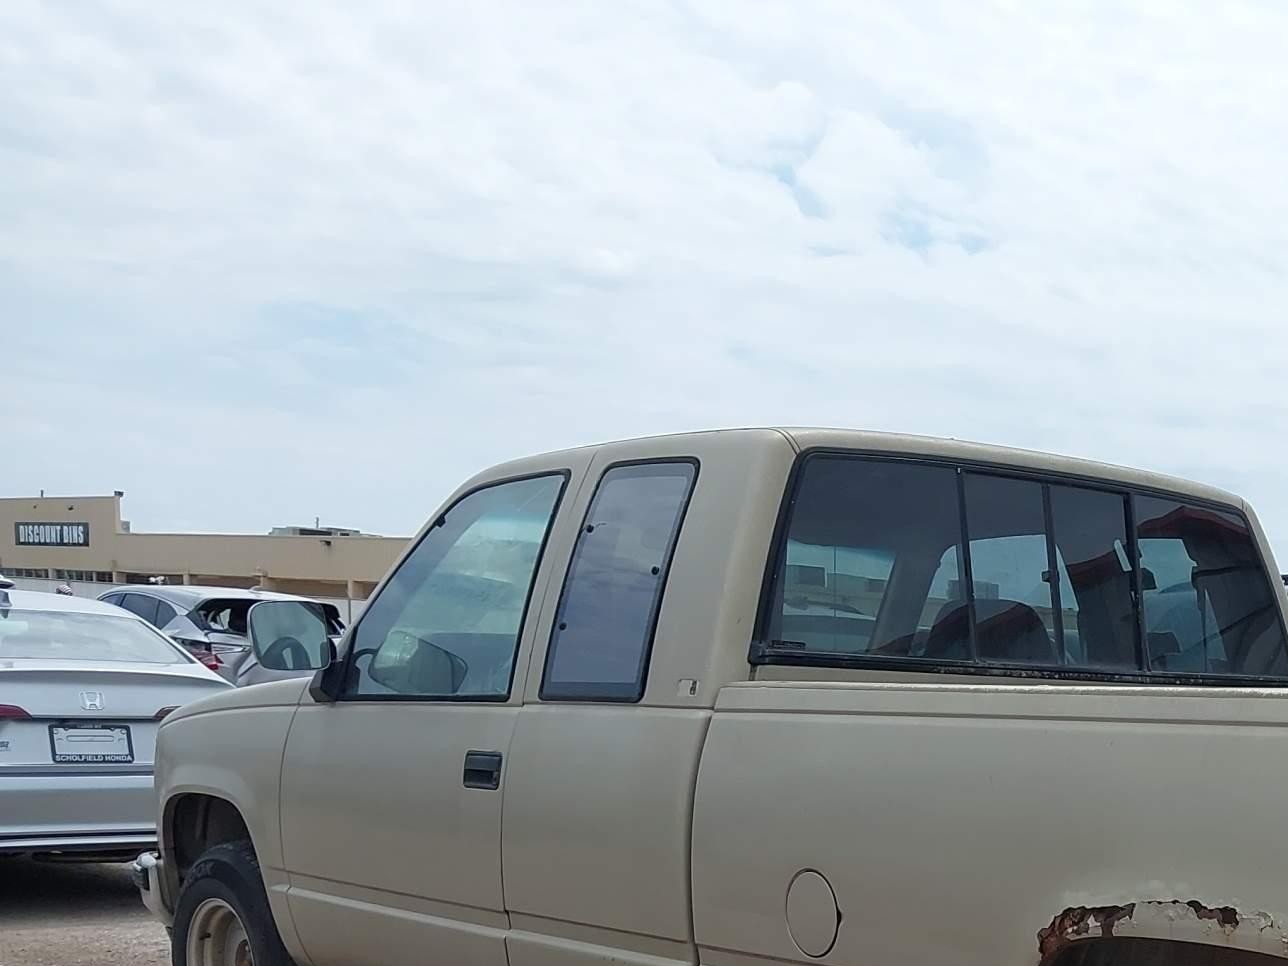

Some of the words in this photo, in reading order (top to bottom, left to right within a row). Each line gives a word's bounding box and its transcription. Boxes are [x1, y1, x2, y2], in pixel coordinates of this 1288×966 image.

[19, 525, 61, 543] DISCOUNT
[63, 526, 84, 544] BINS
[55, 754, 103, 762] SCHOLFIELD
[105, 754, 133, 762] HONDA
